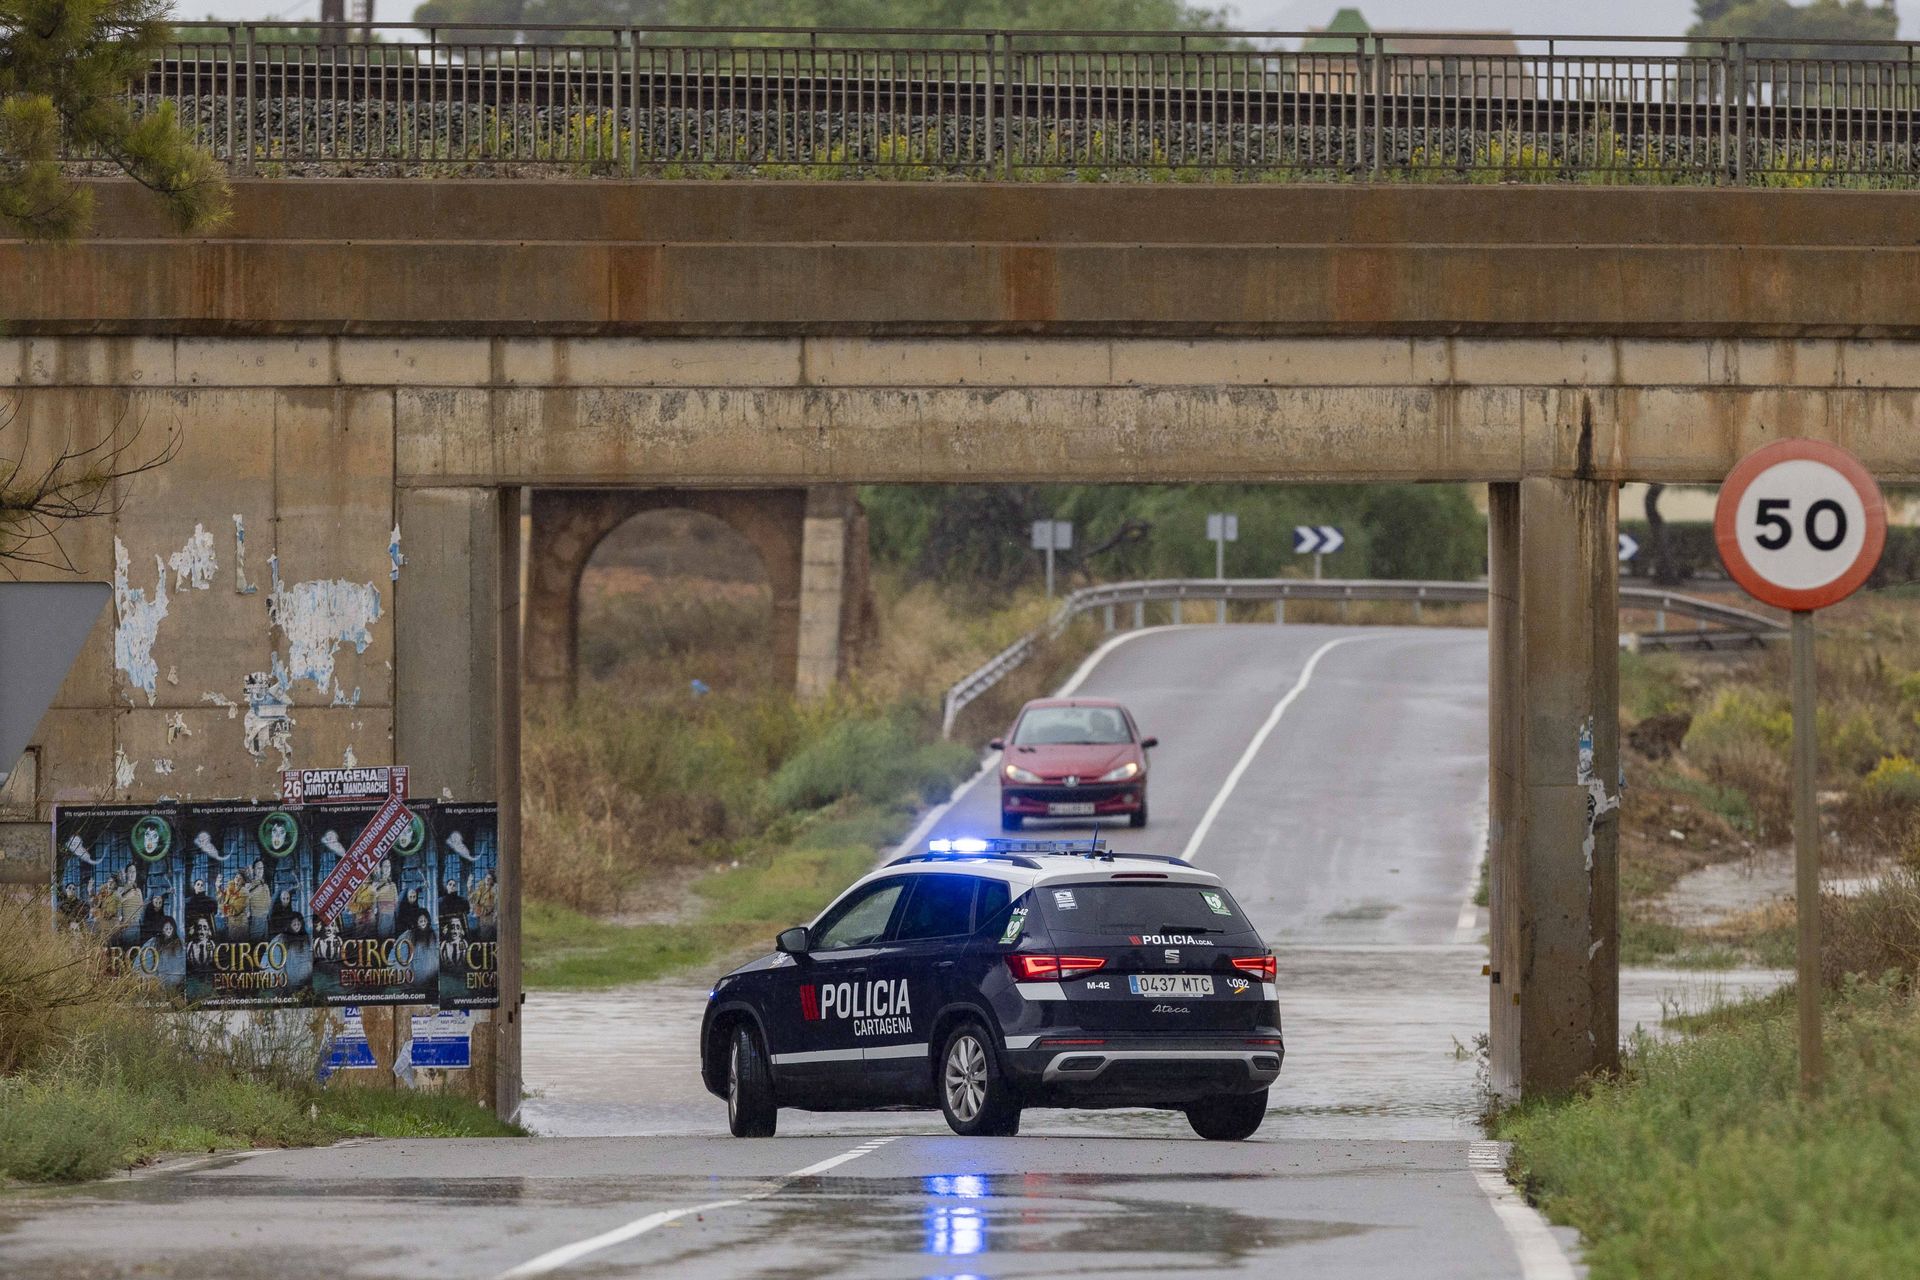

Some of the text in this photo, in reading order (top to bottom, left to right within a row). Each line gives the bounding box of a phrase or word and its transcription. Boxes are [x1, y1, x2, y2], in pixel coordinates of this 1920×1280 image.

[1755, 499, 1847, 551] 50
[303, 769, 378, 783] CARTAGENA
[283, 781, 302, 798] 26
[303, 784, 325, 796] JUNTO
[327, 783, 342, 794] C.C.
[343, 781, 388, 794] MANDARACHE
[395, 777, 404, 793] 5
[325, 812, 409, 920] HASTA EL 12 OCTUBRE
[1013, 908, 1028, 916] M-42
[1143, 935, 1195, 945] POLICIA
[214, 942, 287, 971] CIRCO
[341, 939, 414, 968] CIRCO
[213, 972, 287, 990] ENCANTADO
[340, 968, 415, 987] ENCANTADO
[1140, 977, 1210, 992] 0437 MTC
[1232, 978, 1250, 989] 092
[1086, 982, 1110, 990] M-42
[327, 993, 425, 1002] www.elcircoencantado.com
[821, 979, 911, 1020] POLICIA
[1152, 1004, 1191, 1013] Ateca
[853, 1016, 912, 1037] CARTAGENA
